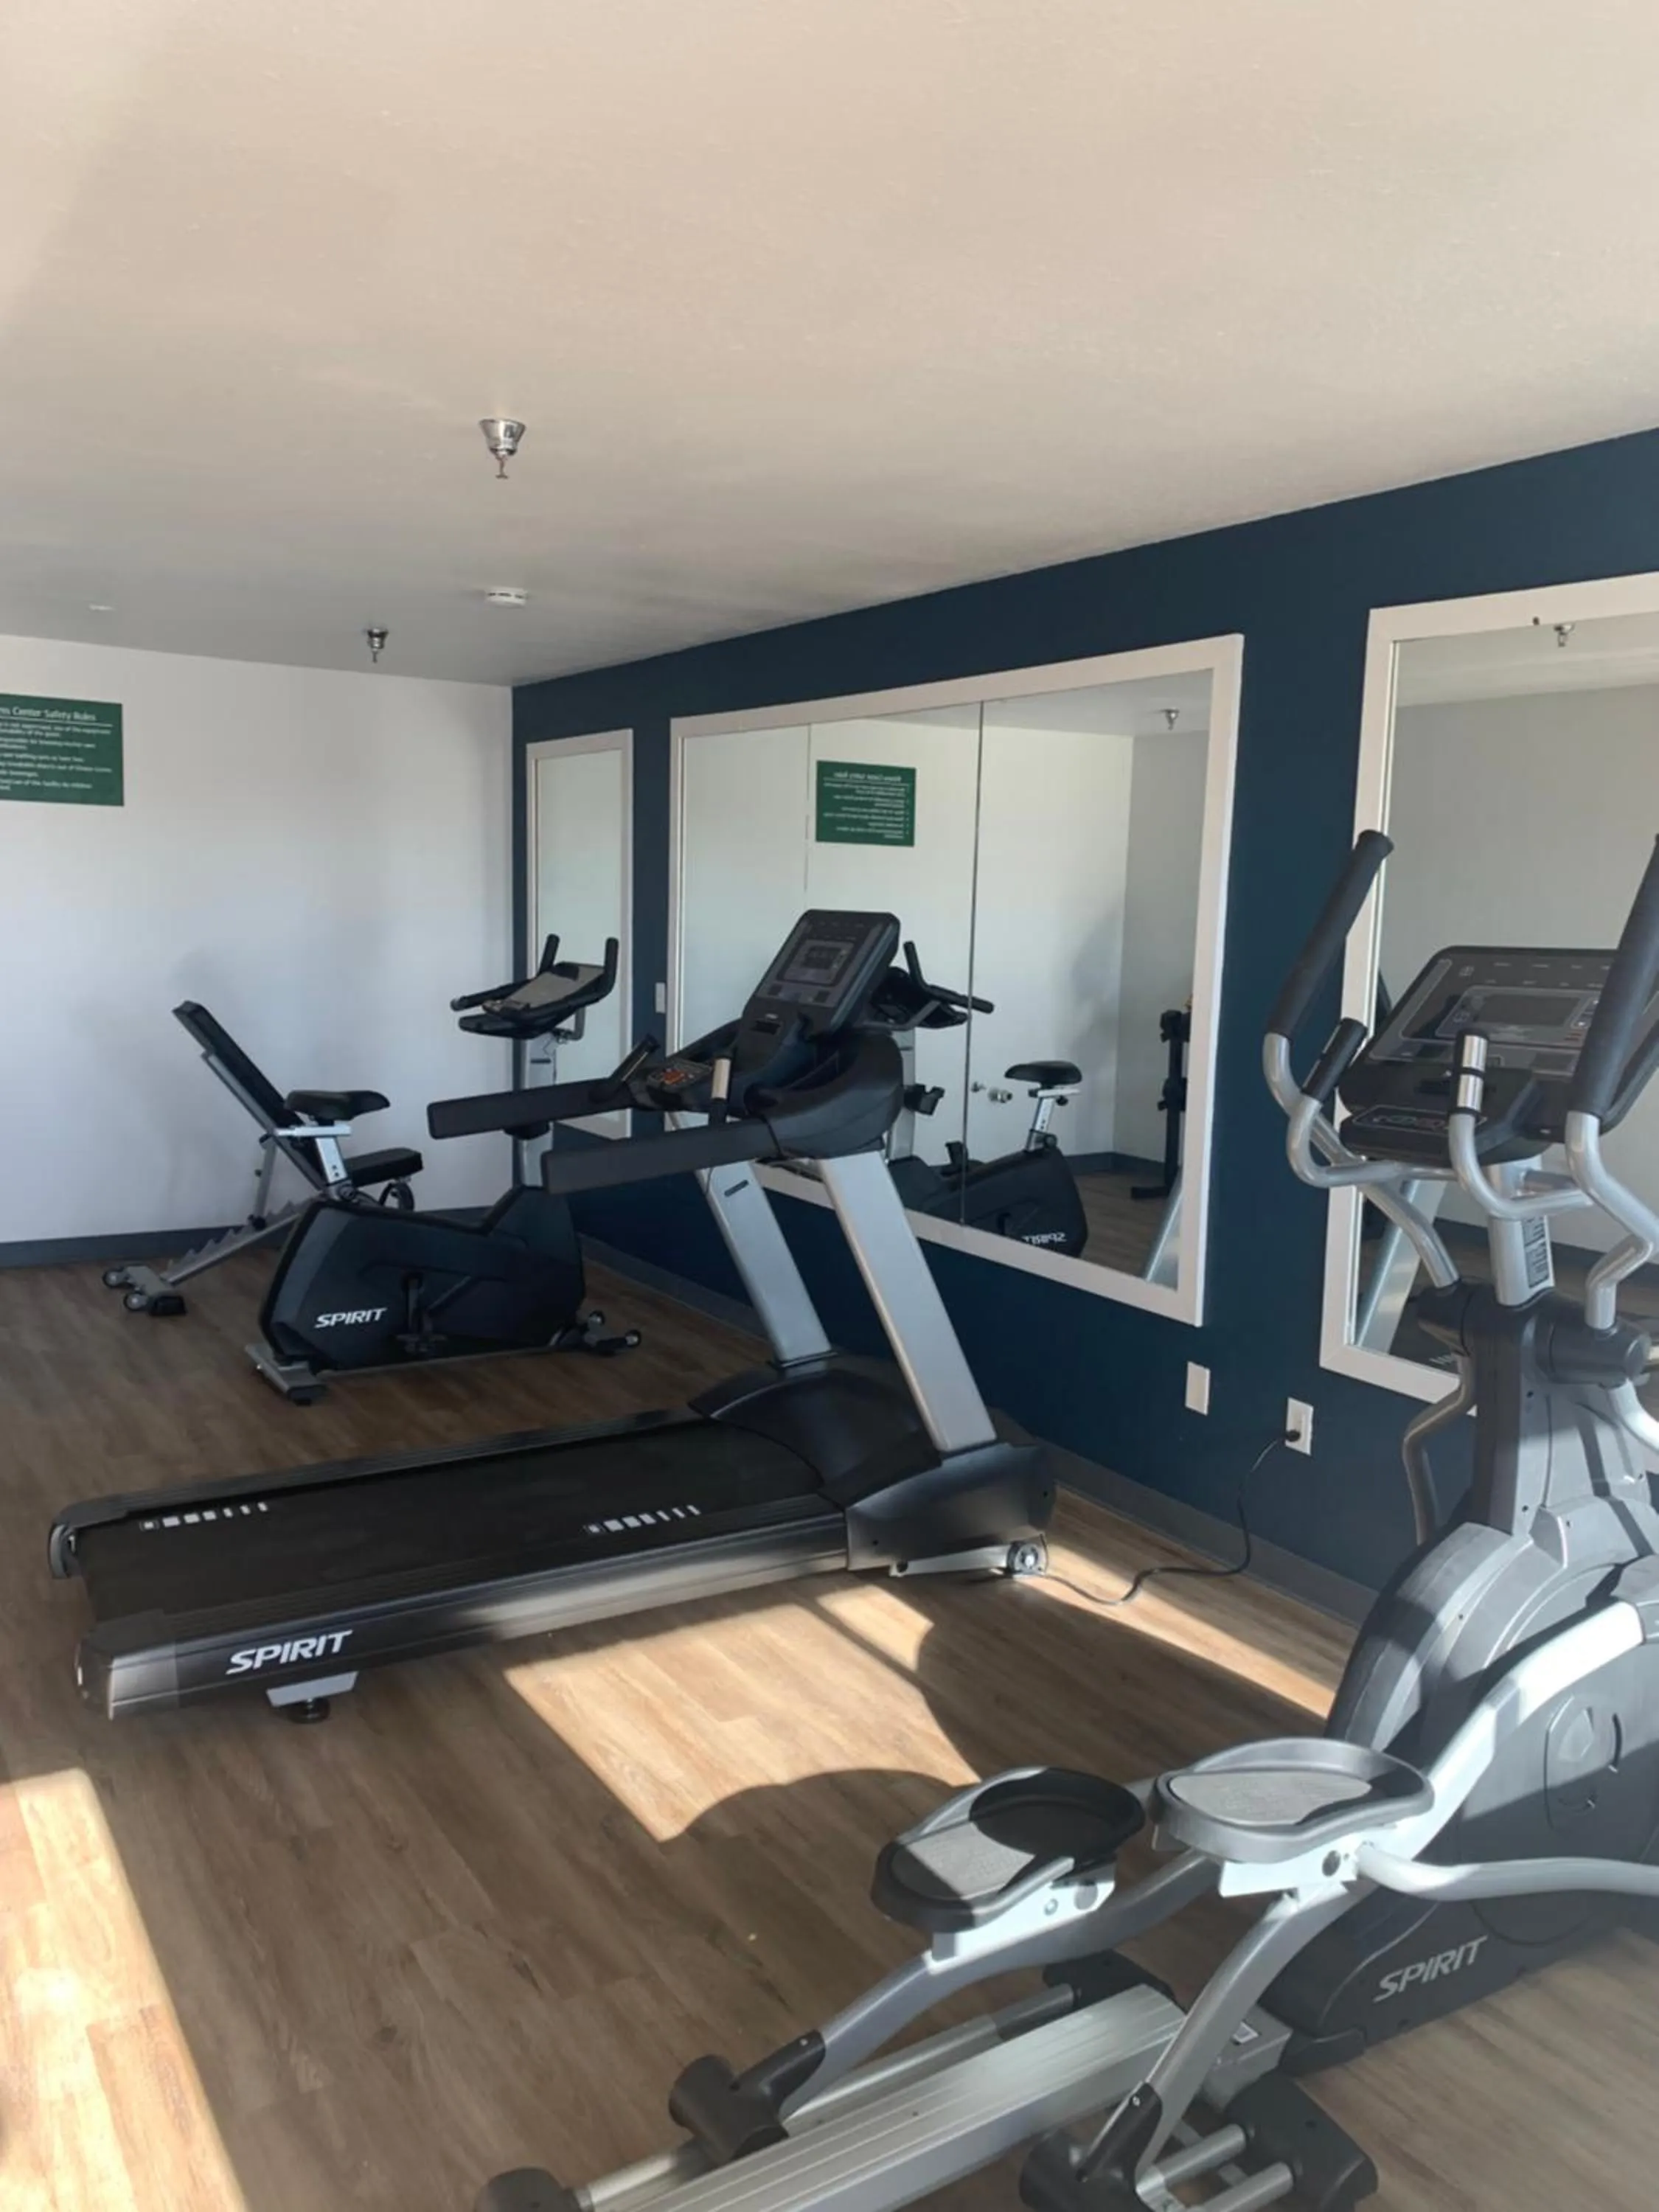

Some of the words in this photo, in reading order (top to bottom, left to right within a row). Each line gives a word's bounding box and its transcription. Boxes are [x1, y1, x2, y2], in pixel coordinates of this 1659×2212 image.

[314, 1307, 388, 1329] SPIRIT
[226, 1630, 353, 1675] SPIRIT
[1373, 1934, 1488, 2003] SPIRIT
